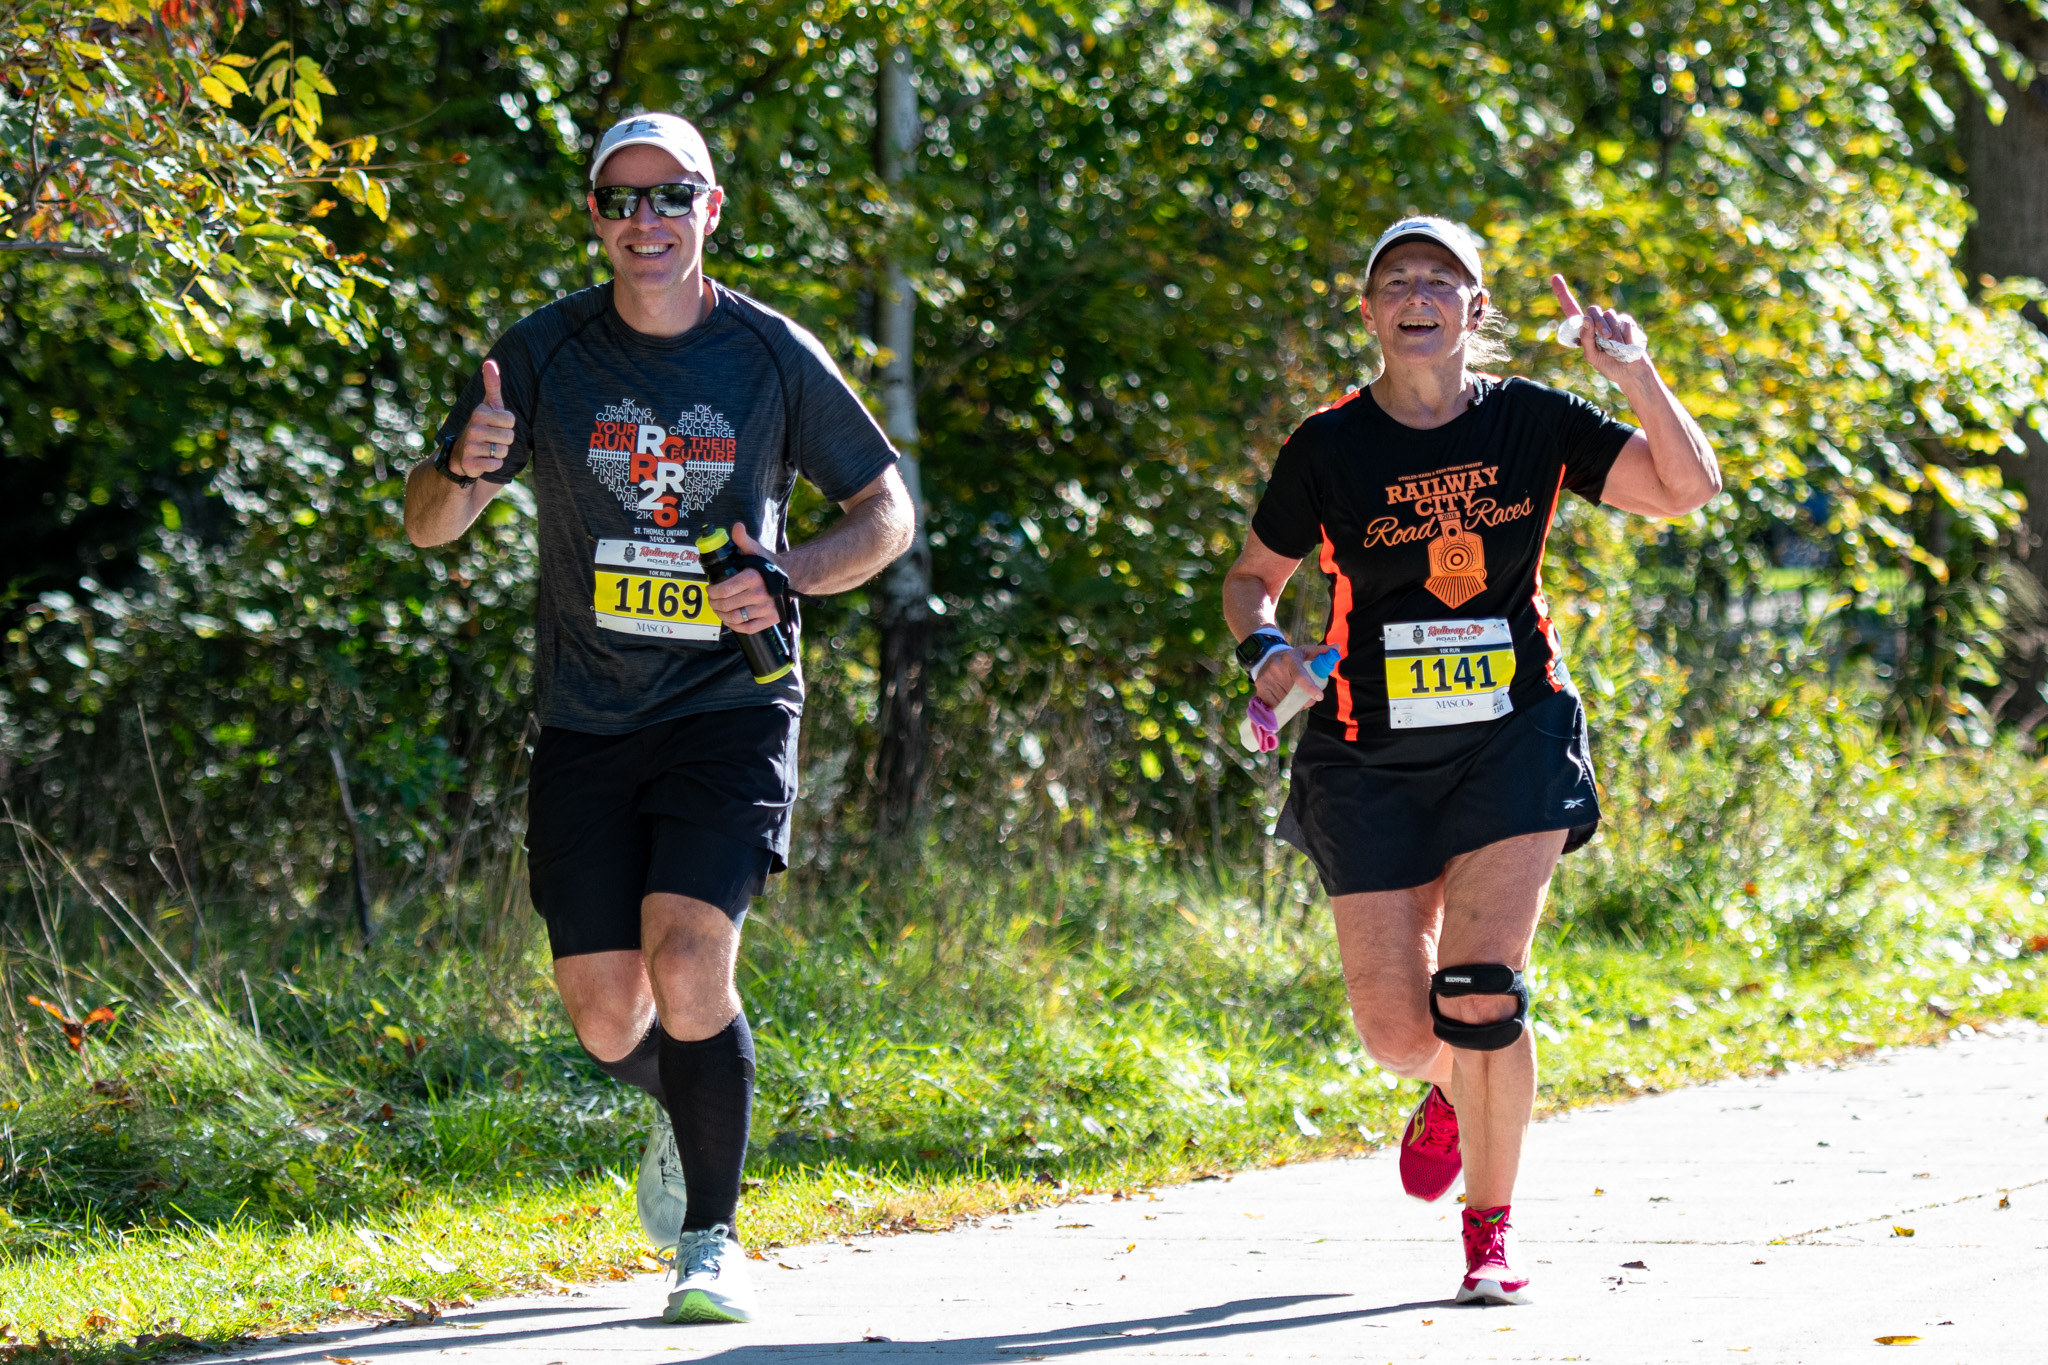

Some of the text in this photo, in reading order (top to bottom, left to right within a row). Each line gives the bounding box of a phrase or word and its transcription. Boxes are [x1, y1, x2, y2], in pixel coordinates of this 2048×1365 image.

[622, 398, 636, 408] 5K
[694, 404, 712, 414] 10K
[604, 405, 652, 417] TRAINING
[681, 411, 724, 422] BELIEVE
[595, 412, 656, 425] COMMUNITY
[595, 420, 638, 437] YOUR
[677, 419, 730, 431] SUCCESS
[668, 426, 736, 439] CHALLENGE
[589, 431, 636, 453] RUN
[689, 437, 737, 451] THEIR
[670, 447, 736, 463] FUTURE
[586, 458, 630, 471] STRONG
[592, 467, 630, 478] FINISH
[685, 470, 731, 481] COURSE
[598, 475, 630, 486] UNITY
[684, 478, 725, 489] INSPIRE
[1385, 465, 1499, 505] RAILWAY
[608, 484, 638, 495] RACE
[684, 485, 720, 496] SPRINT
[616, 492, 638, 502] WIN
[682, 494, 713, 504] WALK
[1414, 489, 1476, 517] CITY
[682, 500, 705, 512] RUN
[636, 510, 653, 520] 21K
[1442, 512, 1457, 521] 2016
[1363, 497, 1535, 549] Road Races
[634, 527, 690, 538] ST. THOMAS, ONTARIO
[649, 535, 673, 544] MASCO
[639, 545, 700, 564] Railway City
[647, 557, 669, 565] ROAD
[614, 577, 704, 621] 1169
[635, 622, 670, 634] MASCO
[1427, 623, 1485, 638] Railway City
[1410, 654, 1498, 694] 1141
[1436, 698, 1470, 710] MASCO
